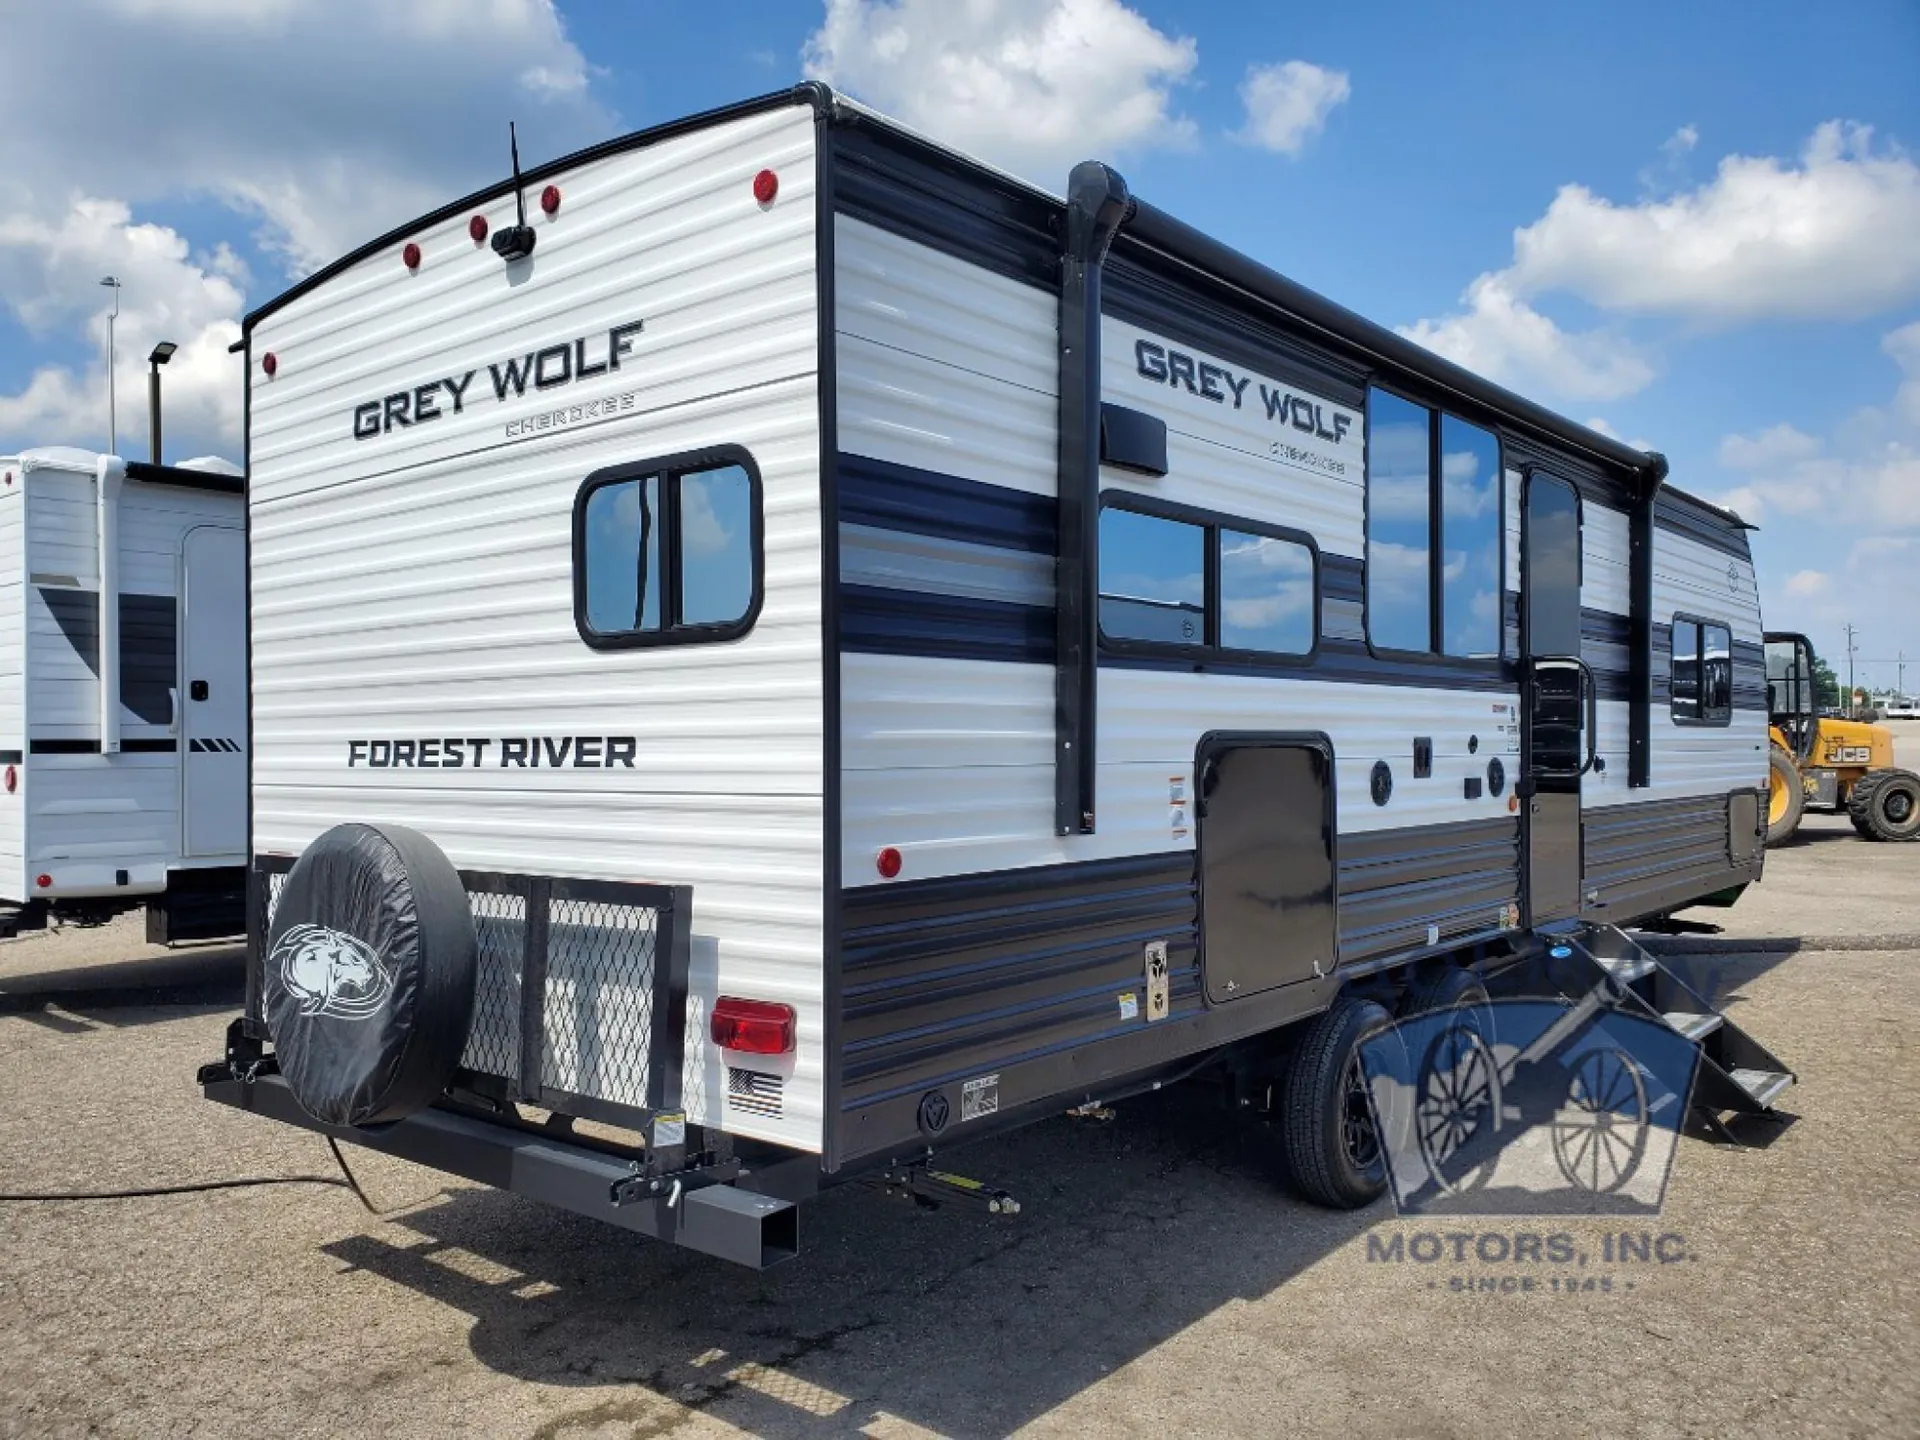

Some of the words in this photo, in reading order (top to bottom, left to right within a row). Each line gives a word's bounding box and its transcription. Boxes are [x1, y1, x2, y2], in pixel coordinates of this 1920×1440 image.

[353, 368, 477, 441] GREY
[488, 319, 645, 402] WOLF
[1135, 338, 1251, 410] GREY
[1260, 383, 1353, 445] WOLF
[505, 391, 636, 438] CHEROKEE
[347, 737, 492, 769] FOREST
[500, 735, 637, 769] RIVER
[1828, 746, 1871, 763] JCB
